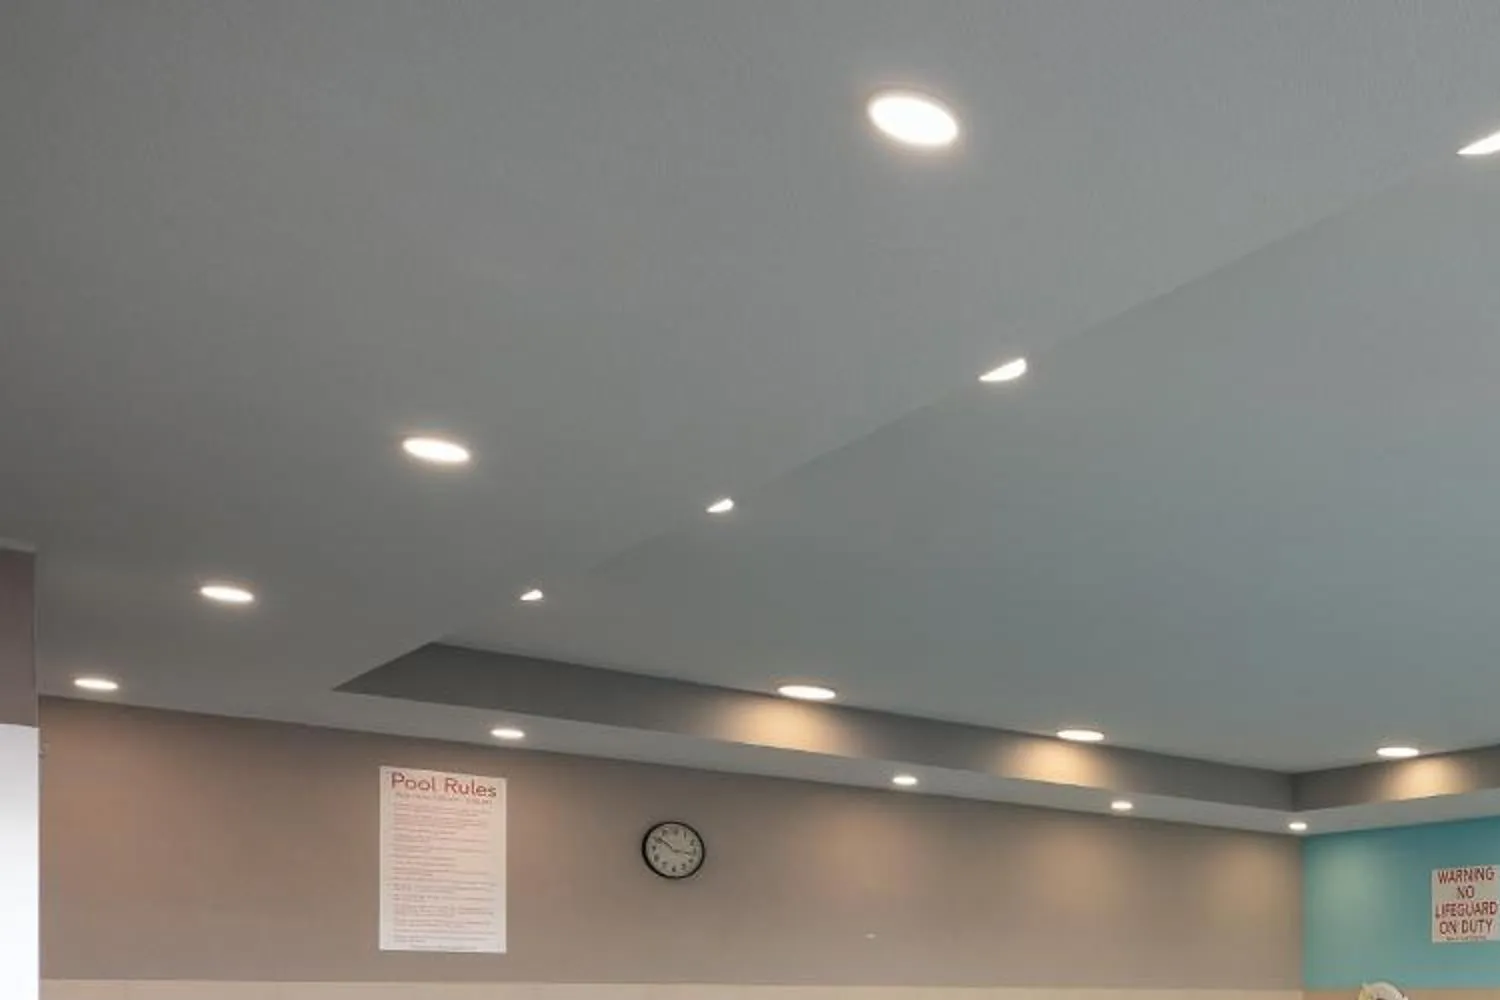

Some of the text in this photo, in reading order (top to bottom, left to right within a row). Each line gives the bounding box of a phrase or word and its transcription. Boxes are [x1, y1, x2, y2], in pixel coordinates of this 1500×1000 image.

[391, 771, 435, 791] Pool
[444, 777, 497, 798] Rules
[1437, 866, 1495, 884] WARNING
[1457, 885, 1475, 899] NO
[1435, 901, 1498, 919] LIFEGUARD
[1439, 919, 1493, 934] ON DUTY
